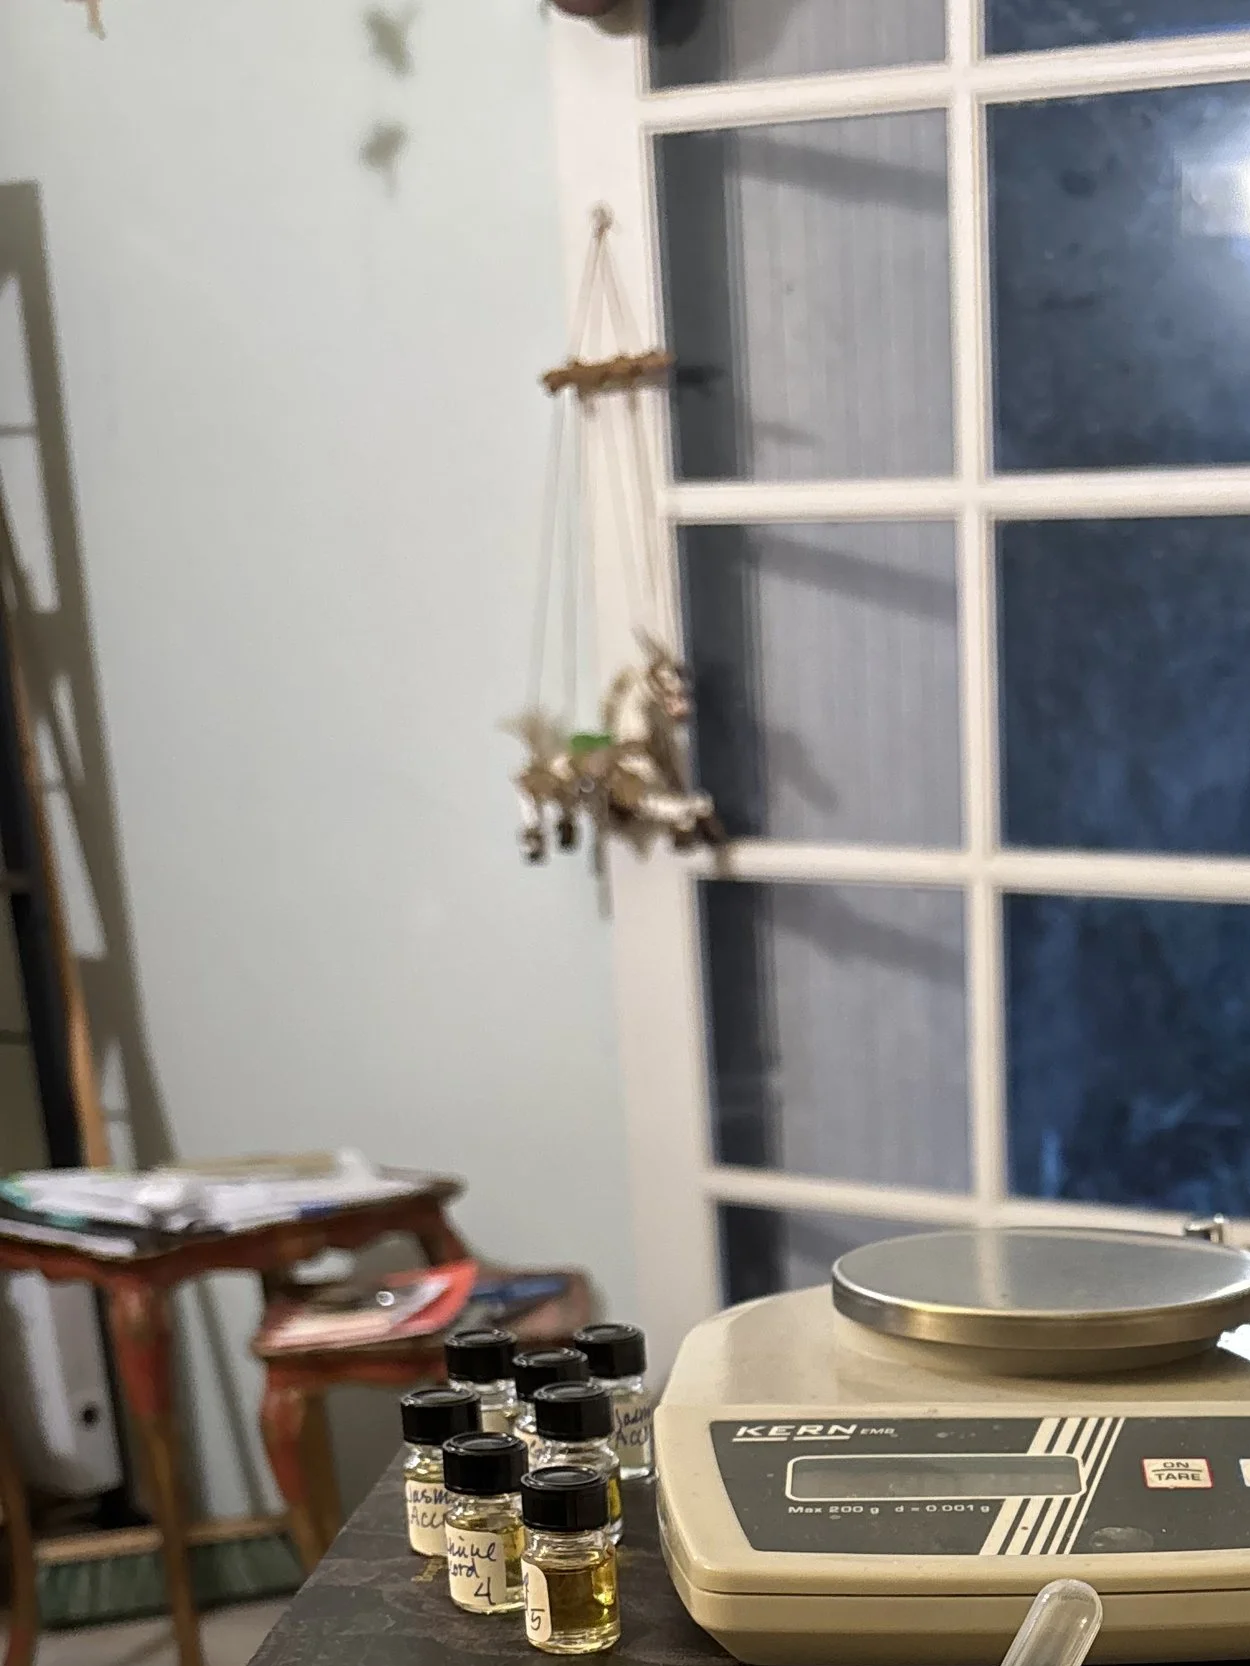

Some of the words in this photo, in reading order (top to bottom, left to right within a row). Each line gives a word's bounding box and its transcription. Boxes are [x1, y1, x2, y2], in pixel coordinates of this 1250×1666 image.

[736, 1424, 857, 1438] KERN
[1162, 1461, 1190, 1469] ON
[1154, 1473, 1203, 1482] TARE
[788, 1506, 823, 1514] Max
[828, 1505, 864, 1514] 200
[870, 1507, 880, 1515] g
[895, 1505, 904, 1513] d
[981, 1505, 990, 1514] g
